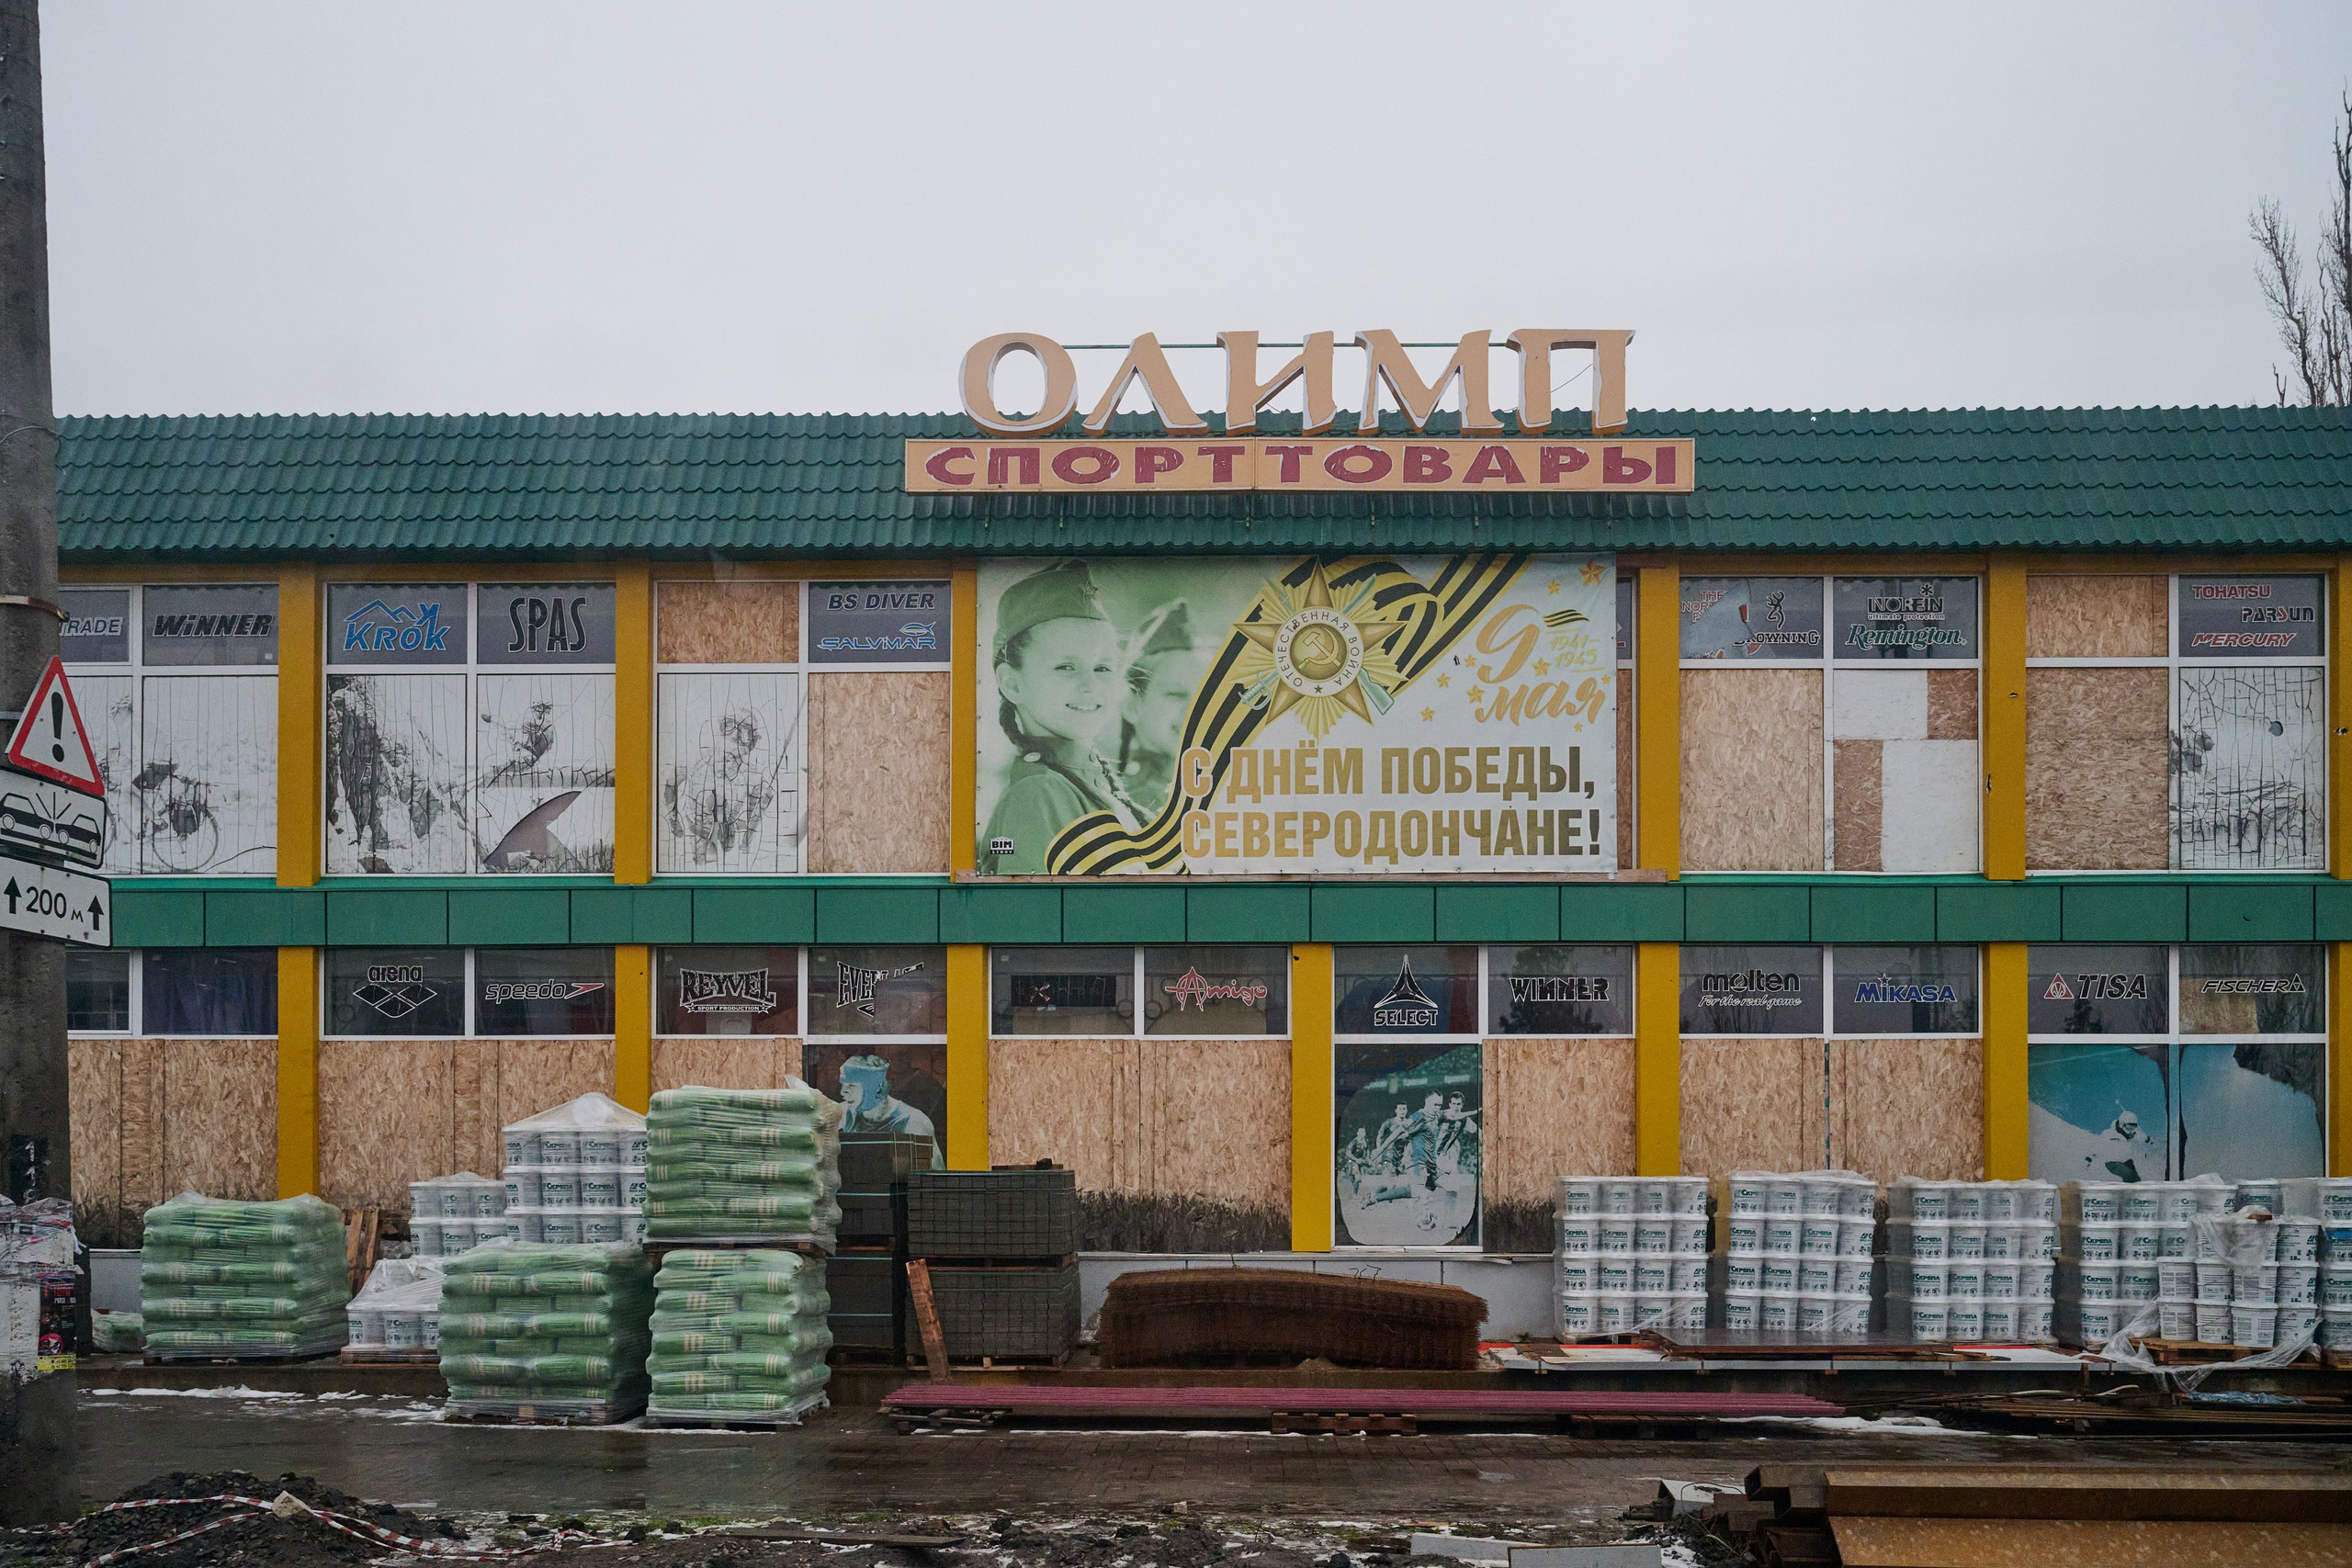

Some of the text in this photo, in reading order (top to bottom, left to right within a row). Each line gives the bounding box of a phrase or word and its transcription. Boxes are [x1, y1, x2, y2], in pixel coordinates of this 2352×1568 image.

[959, 329, 1636, 436] ОЛИМП
[827, 592, 935, 610] BS DIVER
[2192, 585, 2271, 599] TOHATSU
[508, 597, 587, 652] SPAS
[1476, 604, 1540, 683] 9
[2191, 632, 2297, 647] MERCURY
[1474, 677, 1606, 727] мая
[1182, 739, 1596, 804] С ДНЁМ ПОБЕДЫ,
[991, 840, 1012, 849] BIM
[1182, 808, 1601, 865] СЕВЕРОДОНЧАНЕ!
[26, 886, 67, 919] 200
[368, 965, 423, 983] arena
[1702, 969, 1801, 992] molten
[2077, 974, 2147, 999] TISA
[2201, 979, 2290, 994] FISCHER
[485, 979, 566, 1004] speedo
[679, 968, 776, 1007] REYVEL
[1165, 966, 1267, 1011] Amigo
[1510, 977, 1610, 1002] WINNER
[1698, 995, 1720, 1007] For
[1720, 995, 1740, 1006] the
[1766, 998, 1802, 1010] game
[1374, 1009, 1439, 1026] SELECT
